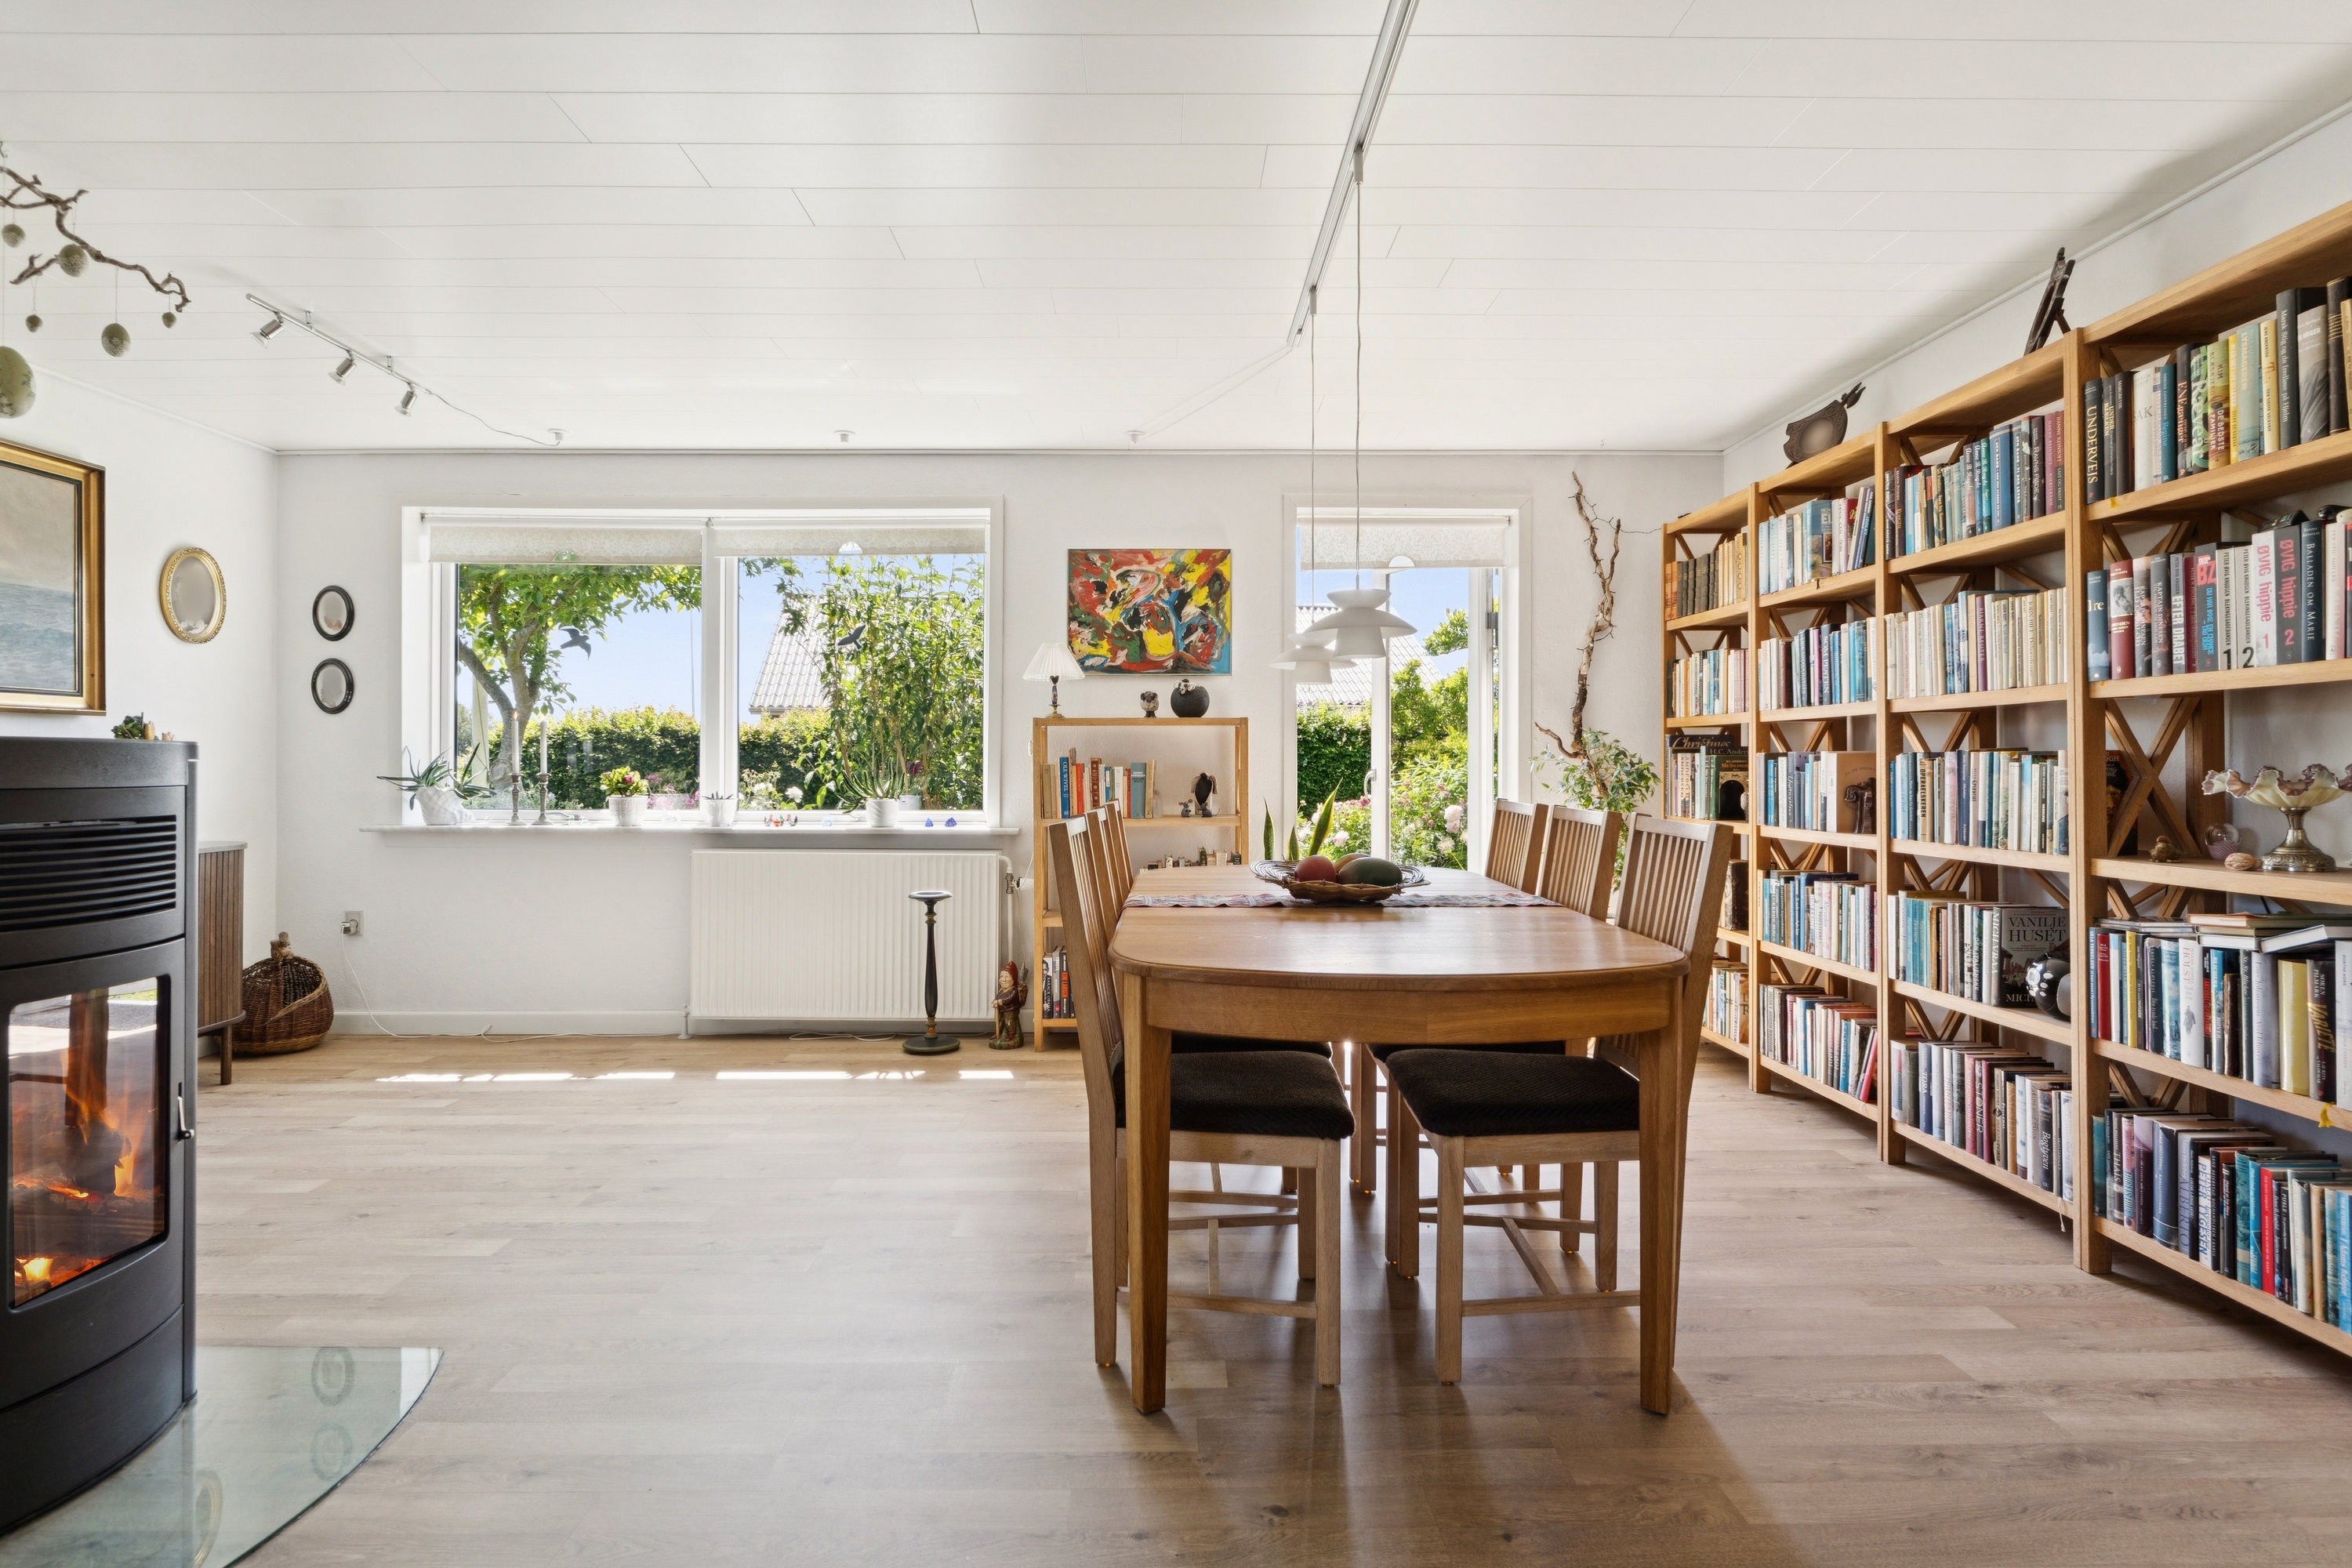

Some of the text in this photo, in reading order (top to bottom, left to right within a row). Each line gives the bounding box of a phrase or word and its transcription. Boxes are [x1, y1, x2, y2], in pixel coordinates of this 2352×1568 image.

[2280, 331, 2289, 346] Stig
[2280, 346, 2288, 354] og
[2281, 355, 2288, 364] de
[2280, 393, 2290, 401] på
[2217, 409, 2225, 419] DE
[2086, 405, 2099, 485] UNDERVEJS
[2196, 559, 2216, 586] BZ
[2256, 545, 2274, 649] ØVIG hippie 1
[2278, 539, 2298, 645] ØVIG hippie 2
[2171, 595, 2184, 666] EFTER DRABET
[2307, 611, 2316, 641] MARIE
[2223, 648, 2231, 670] 1
[2242, 646, 2255, 668] 2
[2009, 916, 2067, 930] VANILJE
[2009, 927, 2067, 942] HUSET
[1991, 912, 2000, 974] MICH VRAA
[2183, 947, 2191, 982] HOLST
[1975, 1082, 1984, 1134] STONER
[2041, 1131, 2051, 1171] Bogtyven
[2198, 1162, 2208, 1255] PETER TYGESEN
[2339, 1241, 2350, 1269] Adams
[2339, 1268, 2350, 1297] fodspor
